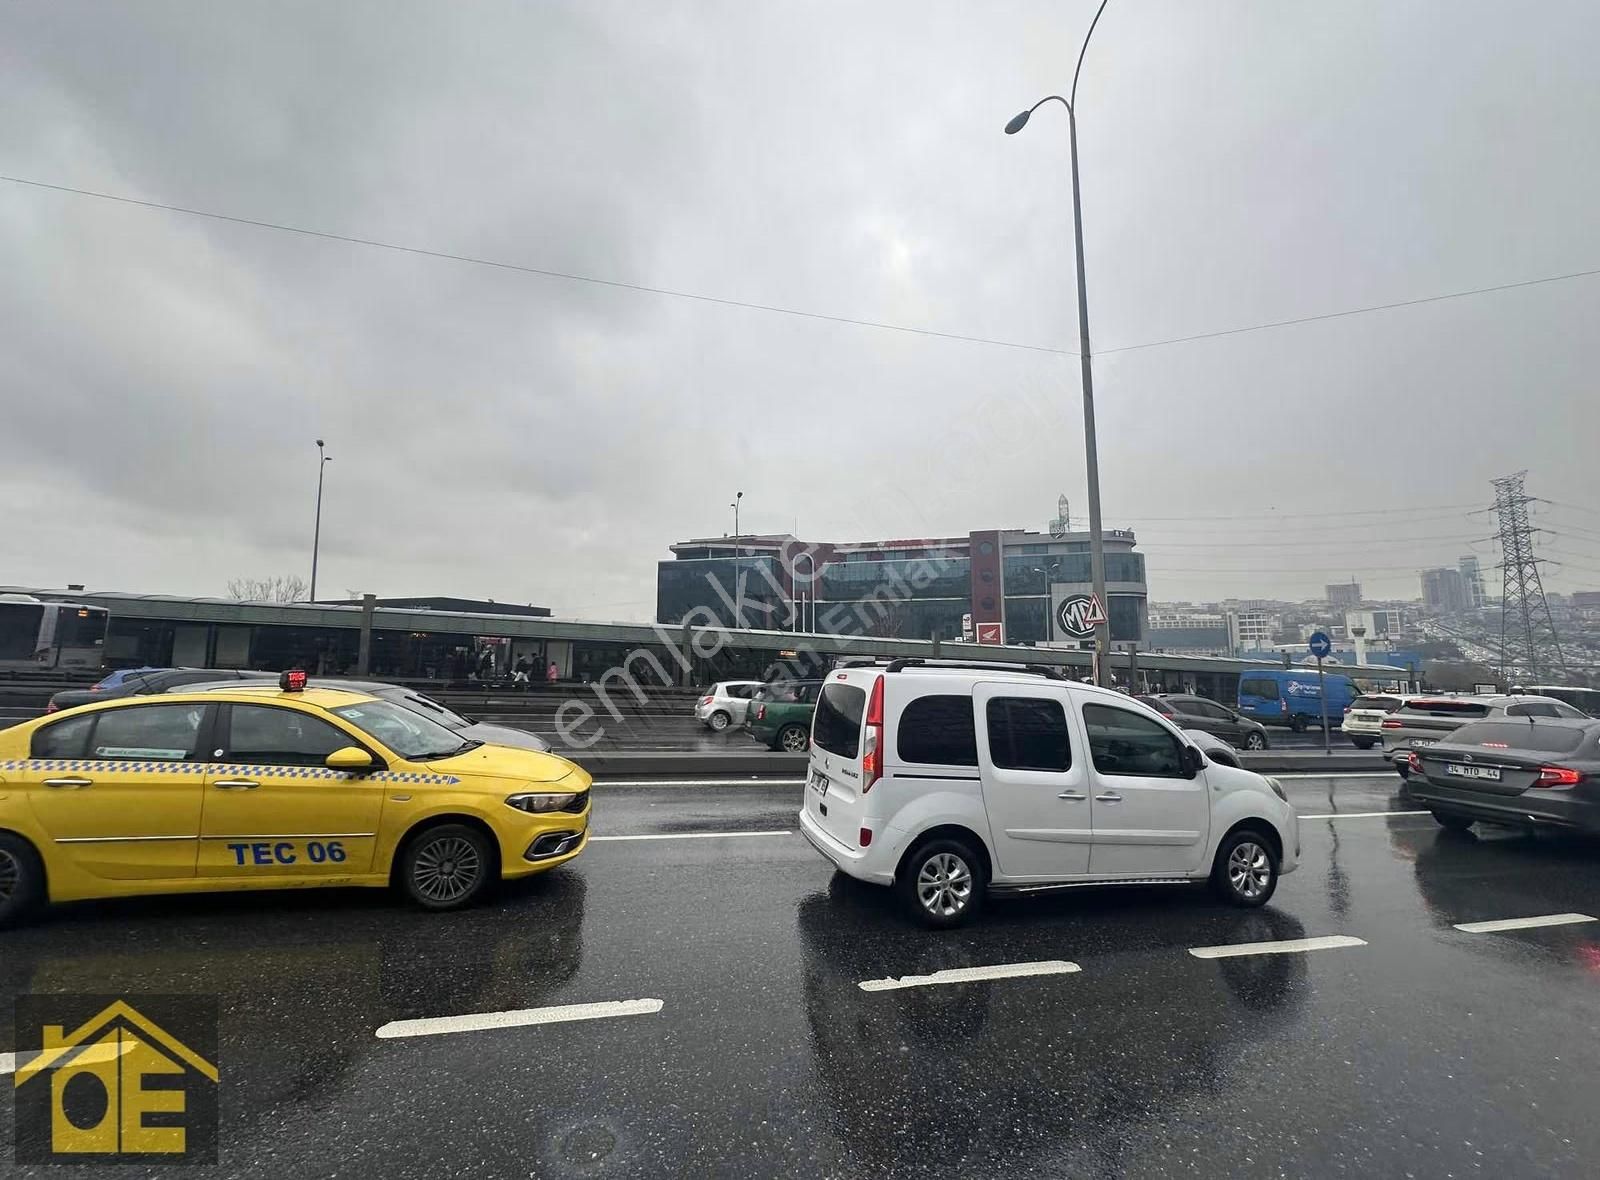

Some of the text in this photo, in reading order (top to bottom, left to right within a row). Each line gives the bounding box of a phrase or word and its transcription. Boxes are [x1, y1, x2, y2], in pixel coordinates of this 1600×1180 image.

[1487, 769, 1498, 778] 44
[227, 841, 346, 865] TEC 06
